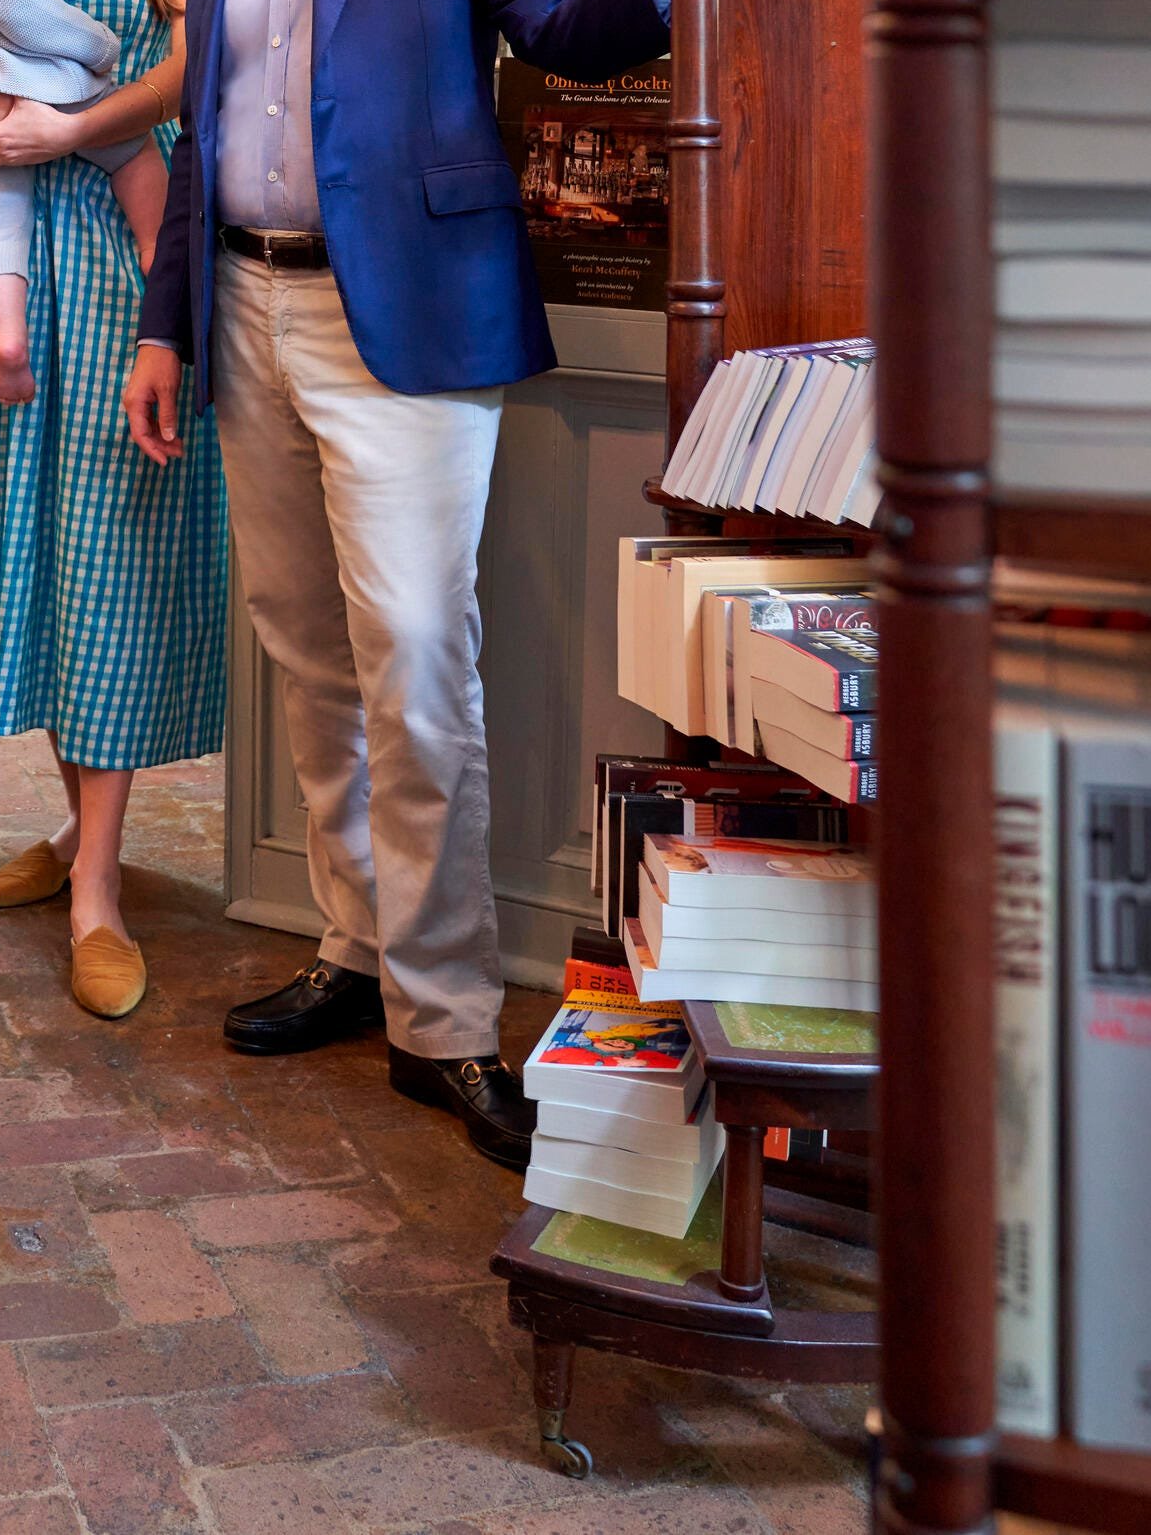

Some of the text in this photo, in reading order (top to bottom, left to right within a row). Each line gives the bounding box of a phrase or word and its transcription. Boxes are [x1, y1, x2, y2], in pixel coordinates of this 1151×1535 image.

[594, 95, 620, 103] Saloons
[620, 96, 629, 104] of
[850, 674, 859, 707] ASBURY
[861, 723, 871, 756] ASBURY
[868, 767, 877, 799] ASBURY
